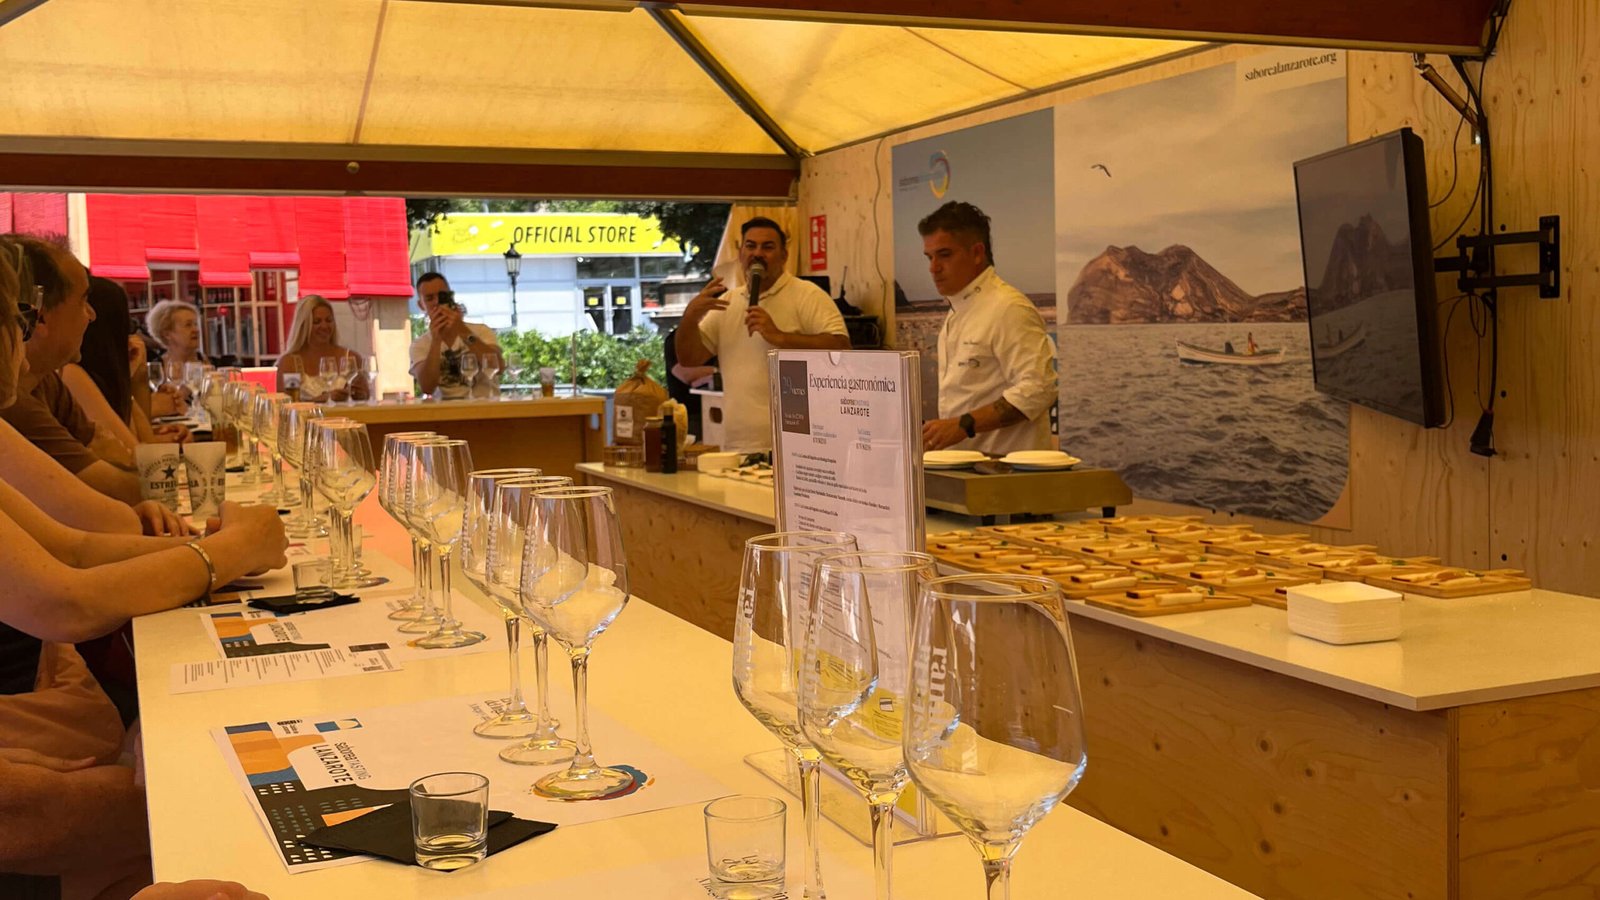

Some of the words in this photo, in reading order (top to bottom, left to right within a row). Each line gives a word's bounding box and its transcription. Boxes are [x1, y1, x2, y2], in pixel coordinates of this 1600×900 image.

[1244, 52, 1338, 81] saborealanzarote.org
[512, 226, 583, 244] OFFICIAL
[587, 226, 637, 243] STORE
[809, 373, 847, 391] Experiencia
[847, 376, 896, 394] gastronómica
[840, 406, 870, 417] LANZAROTE
[312, 744, 354, 783] LANZAROTE
